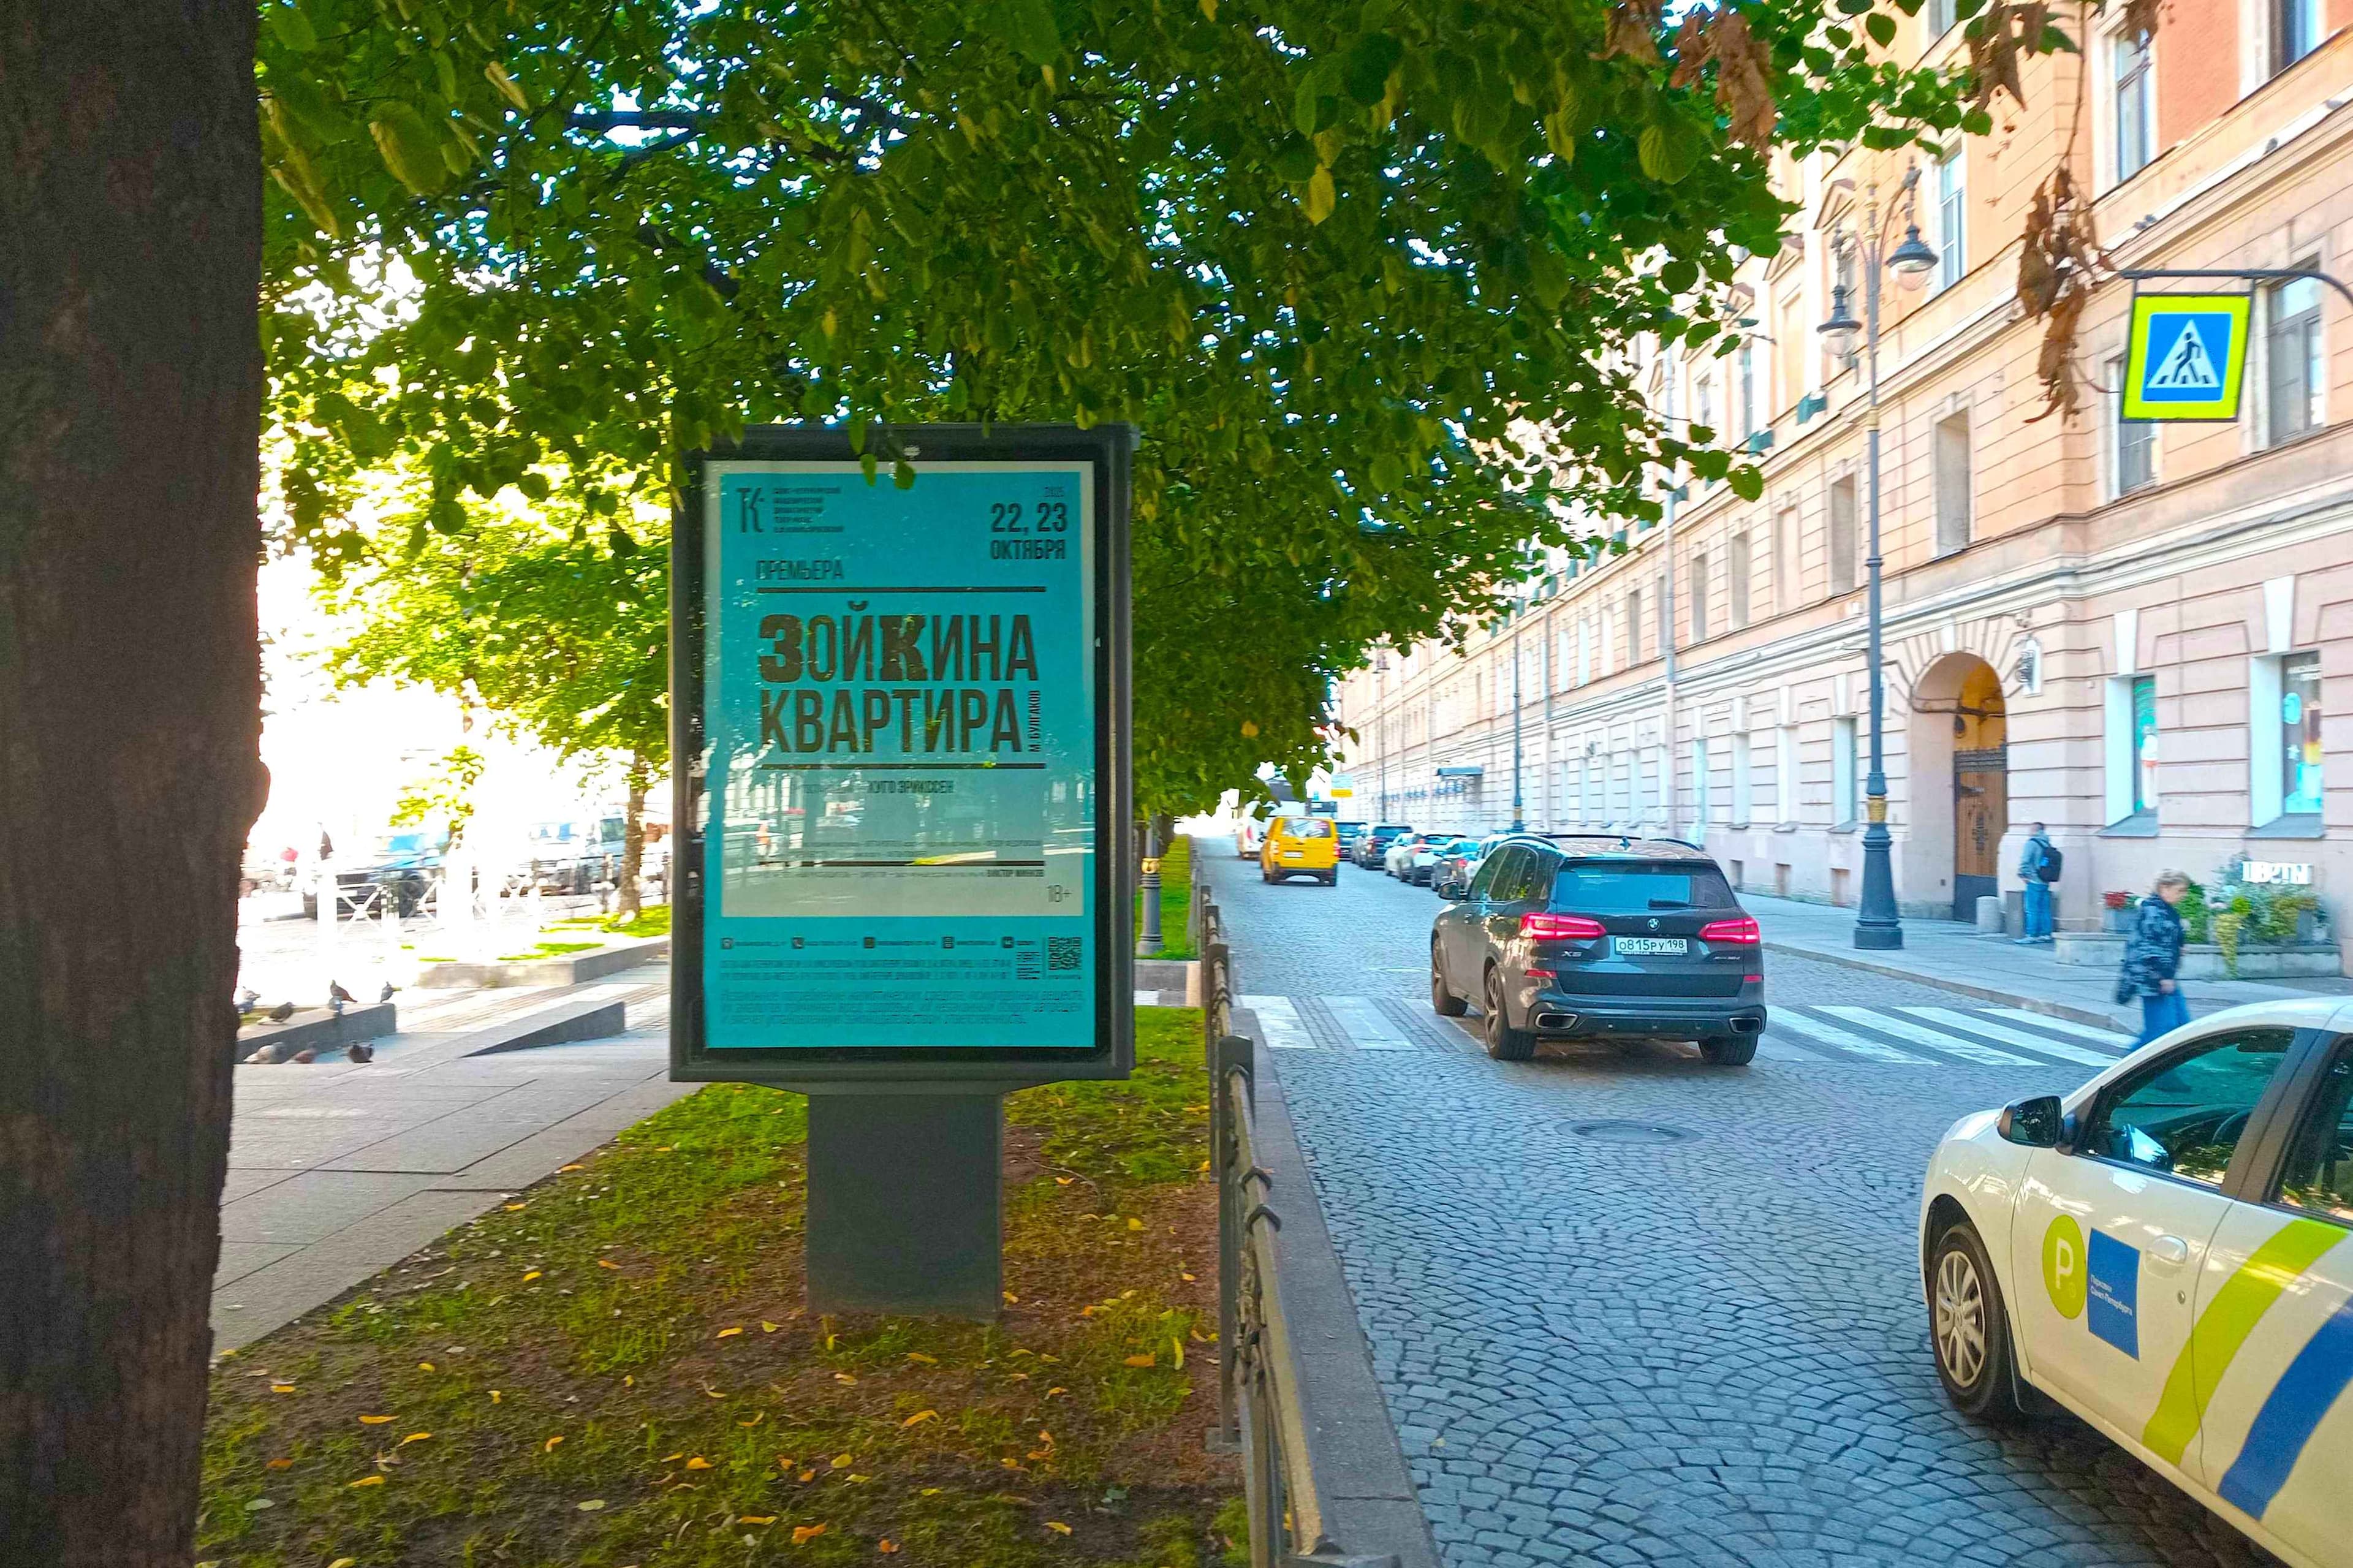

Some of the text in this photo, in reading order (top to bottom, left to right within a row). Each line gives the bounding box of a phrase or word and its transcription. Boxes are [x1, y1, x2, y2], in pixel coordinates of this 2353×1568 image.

[991, 502, 1067, 535] 22, 23
[990, 539, 1066, 559] ОКТЯБРЯ
[756, 559, 844, 580] ПРЕМЬЕРА
[758, 600, 1039, 683] ЗОЙКИНА
[760, 689, 1022, 752] КВАРТИРА
[1028, 690, 1041, 739] БУЛГАКОВ
[2241, 860, 2313, 885] ЦВЕТЫ
[1047, 884, 1072, 903] 18+
[1667, 939, 1685, 949] 198
